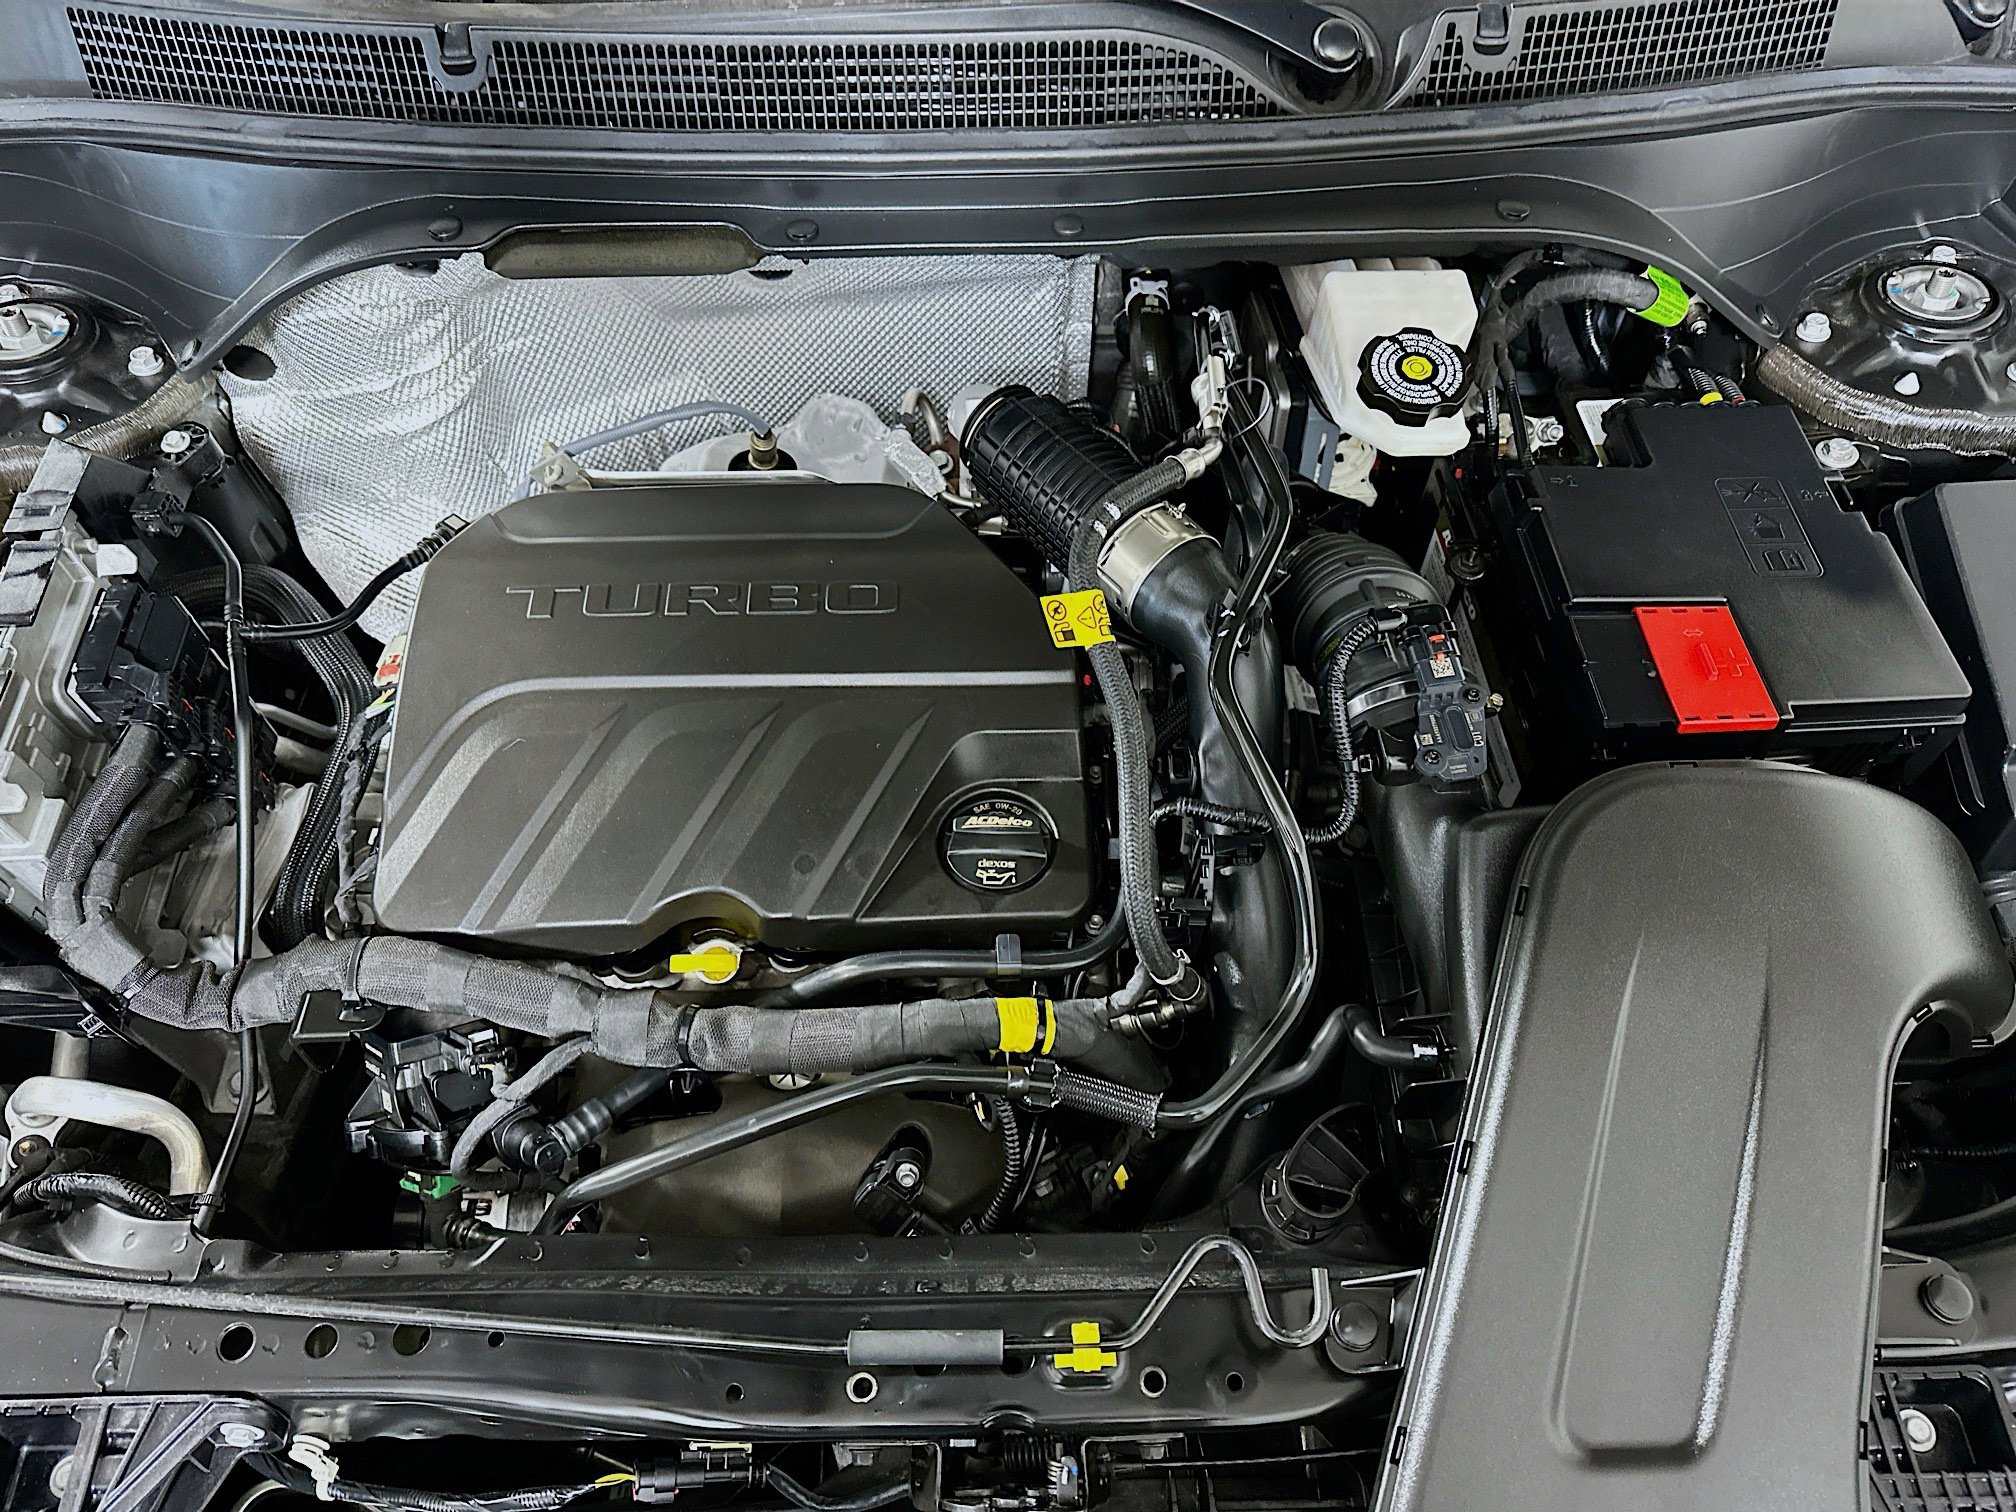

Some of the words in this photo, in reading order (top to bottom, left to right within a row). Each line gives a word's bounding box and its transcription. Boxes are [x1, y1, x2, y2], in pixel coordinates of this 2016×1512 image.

[1431, 338, 1453, 354] SEALED
[505, 580, 900, 619] TURBO
[973, 803, 991, 814] SAE
[963, 816, 1033, 828] ACDelco
[977, 858, 1017, 869] dexos
